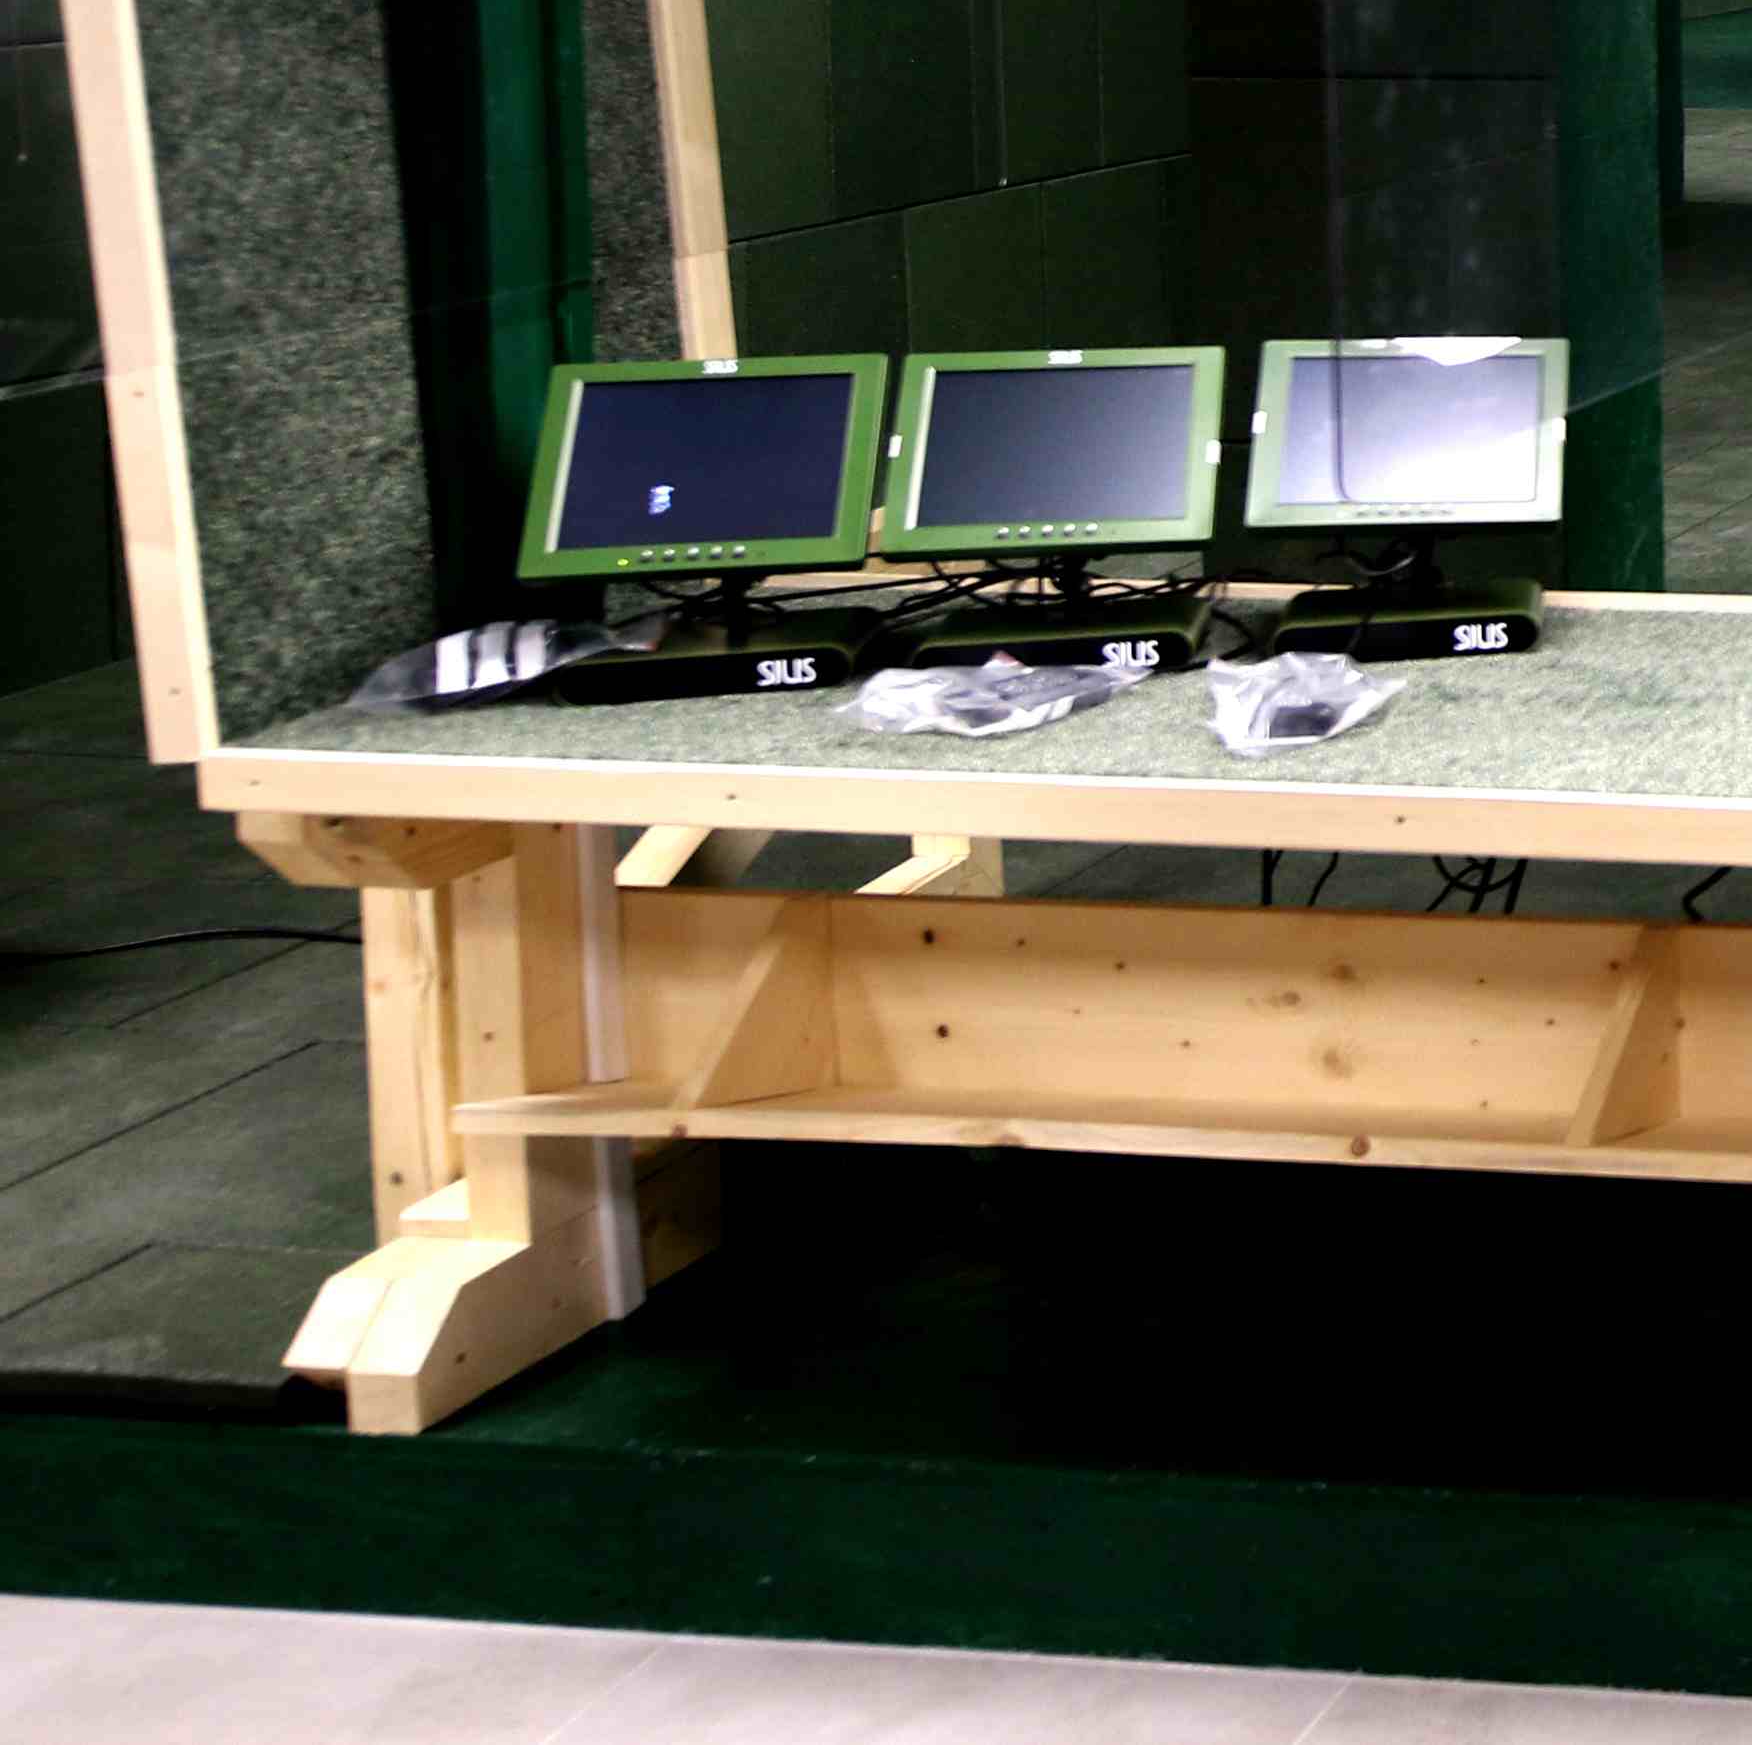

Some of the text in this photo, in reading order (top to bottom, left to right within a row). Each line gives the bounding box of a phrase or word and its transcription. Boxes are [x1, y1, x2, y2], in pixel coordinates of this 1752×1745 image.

[1453, 622, 1509, 651] SIUS
[1101, 640, 1160, 668] SIUS
[756, 657, 817, 686] SIUS
